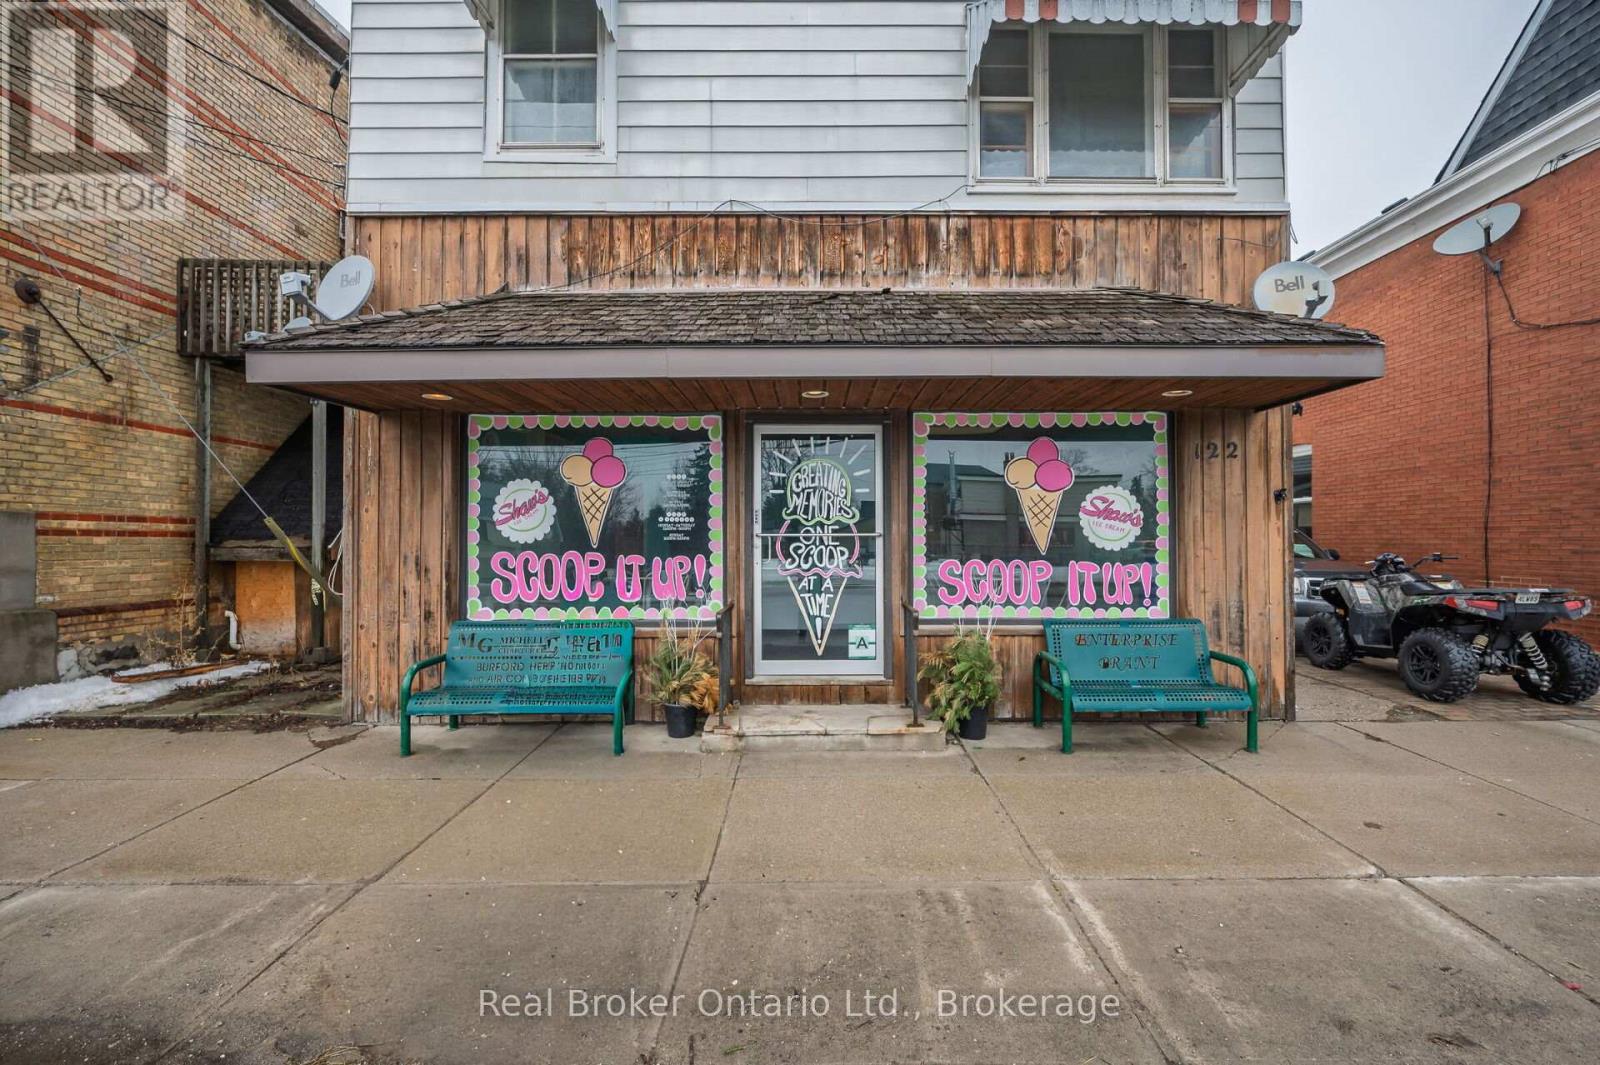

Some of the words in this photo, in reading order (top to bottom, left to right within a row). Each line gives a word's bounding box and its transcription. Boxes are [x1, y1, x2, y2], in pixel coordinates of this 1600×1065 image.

[341, 270, 361, 288] Bell
[1274, 275, 1305, 293] Bell
[1193, 441, 1239, 460] 122
[791, 461, 846, 498] CREATING
[786, 488, 853, 521] MEMORIES
[1079, 495, 1143, 528] Shaw's
[800, 525, 840, 546] ONE
[785, 542, 849, 570] SCOOP
[490, 551, 606, 604] SCOOP
[616, 554, 646, 602] IT
[651, 553, 707, 601] UP!
[798, 576, 817, 590] AT
[821, 578, 834, 591] A
[938, 558, 1053, 605] SCOOP
[1068, 559, 1100, 606] IT
[1102, 561, 1152, 607] UP!
[800, 593, 834, 618] TIME
[856, 637, 868, 649] A
[1075, 633, 1178, 648] ENTERPRISE
